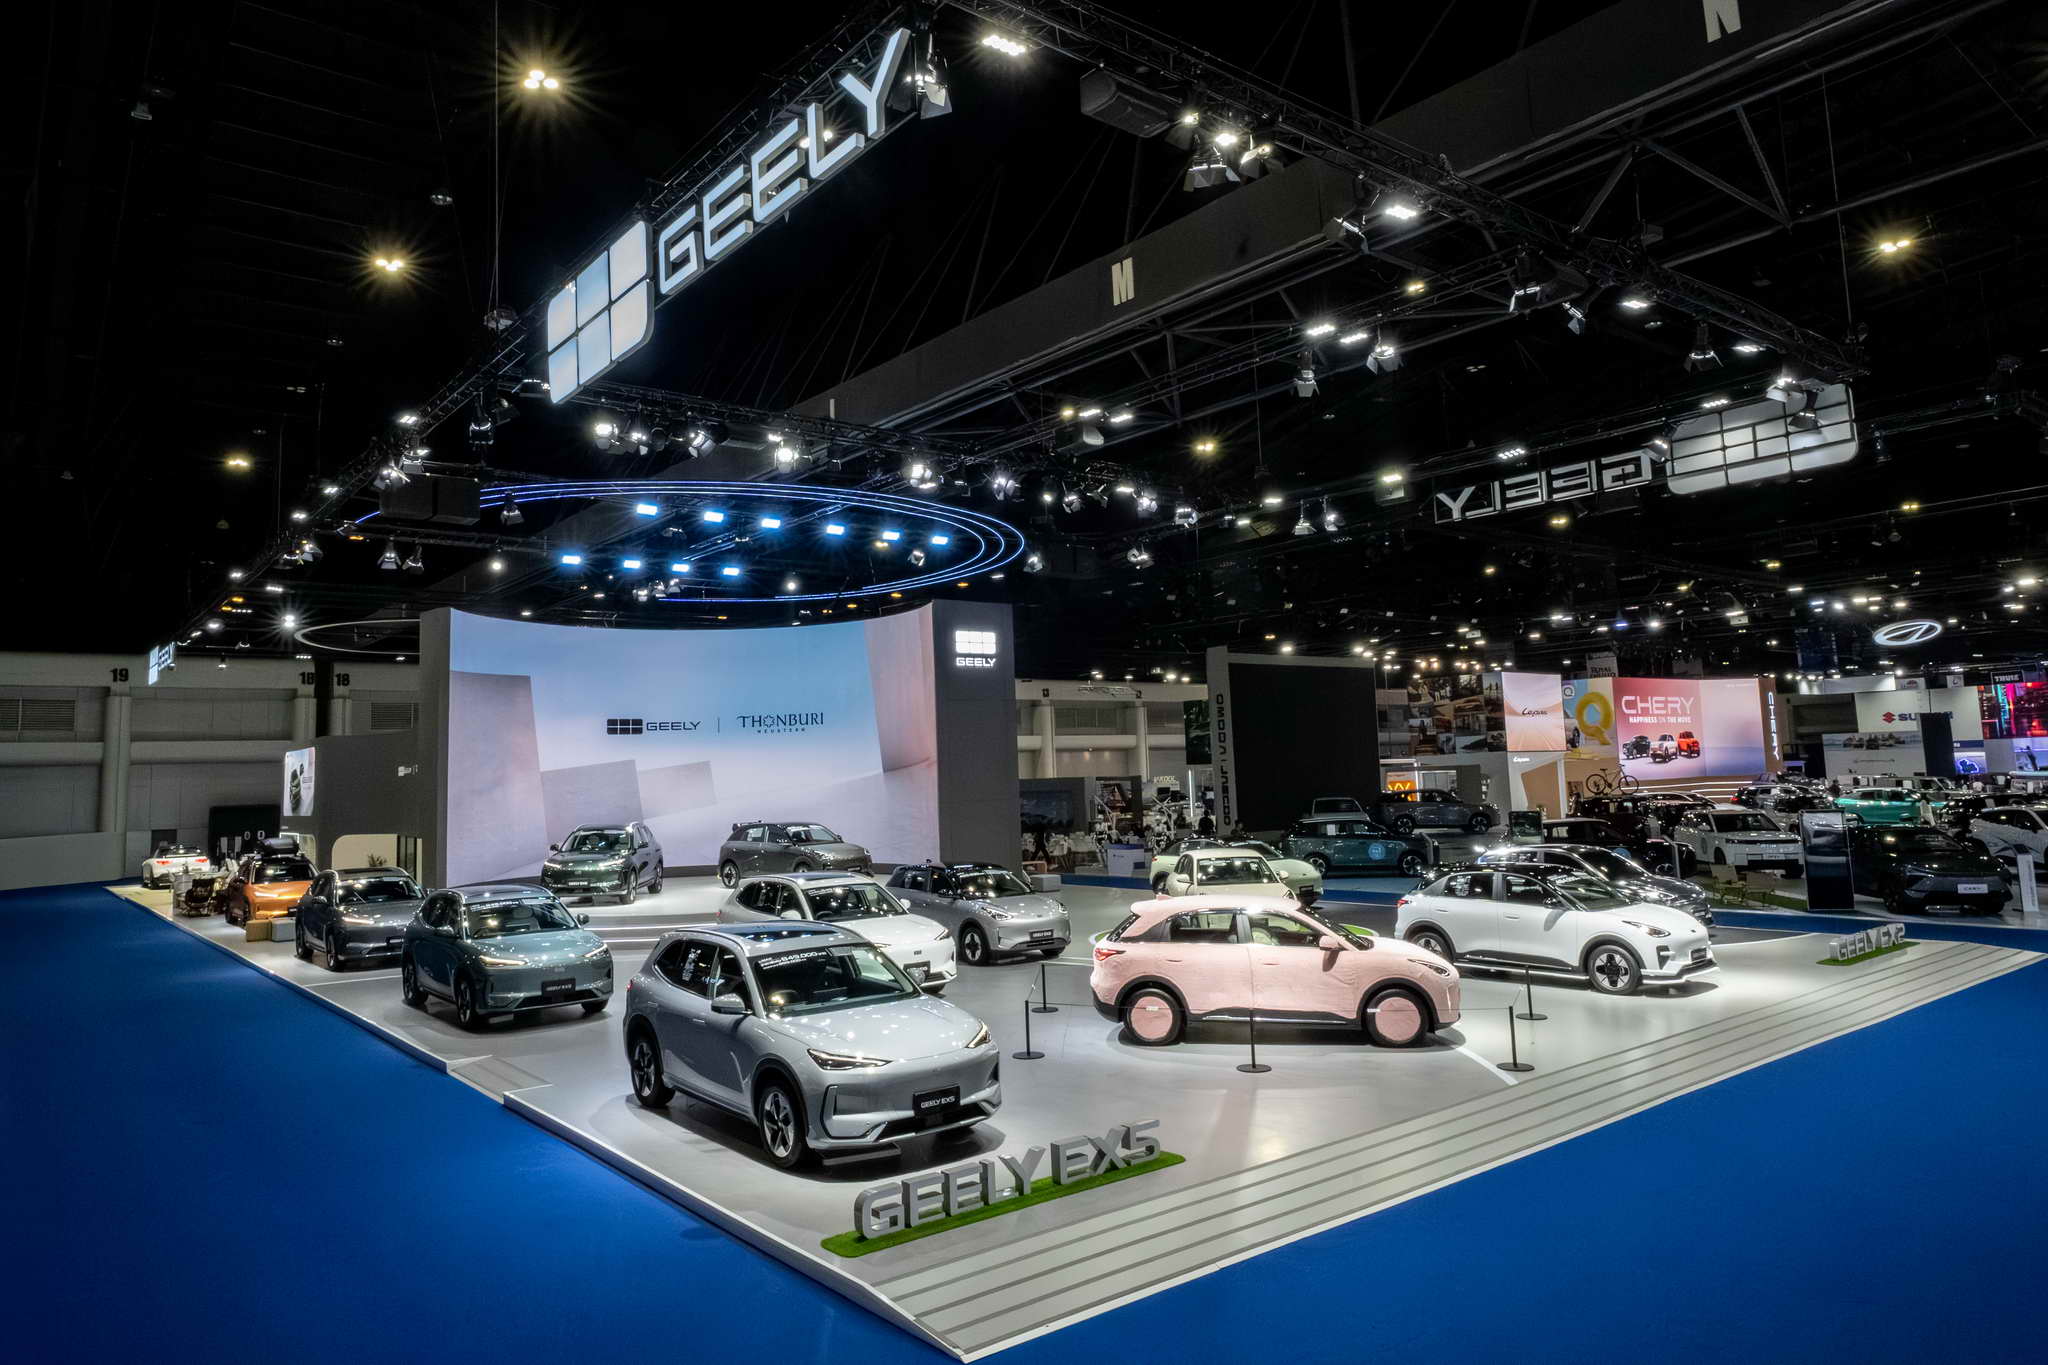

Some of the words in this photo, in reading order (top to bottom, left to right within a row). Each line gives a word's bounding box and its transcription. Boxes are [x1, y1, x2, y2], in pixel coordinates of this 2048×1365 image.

[659, 27, 910, 295] GEELY
[1111, 256, 1135, 305] M
[955, 656, 997, 667] GEELY
[110, 668, 129, 683] 19
[335, 673, 350, 687] 18
[1621, 696, 1695, 715] CHERY
[646, 720, 702, 731] GEELY
[735, 711, 824, 729] THONBURI
[1829, 929, 1878, 961] GEELY
[920, 1097, 941, 1109] GEELY
[941, 1095, 956, 1105] EX5
[853, 1145, 1047, 1239] GEELY
[1050, 1119, 1160, 1186] EX5
